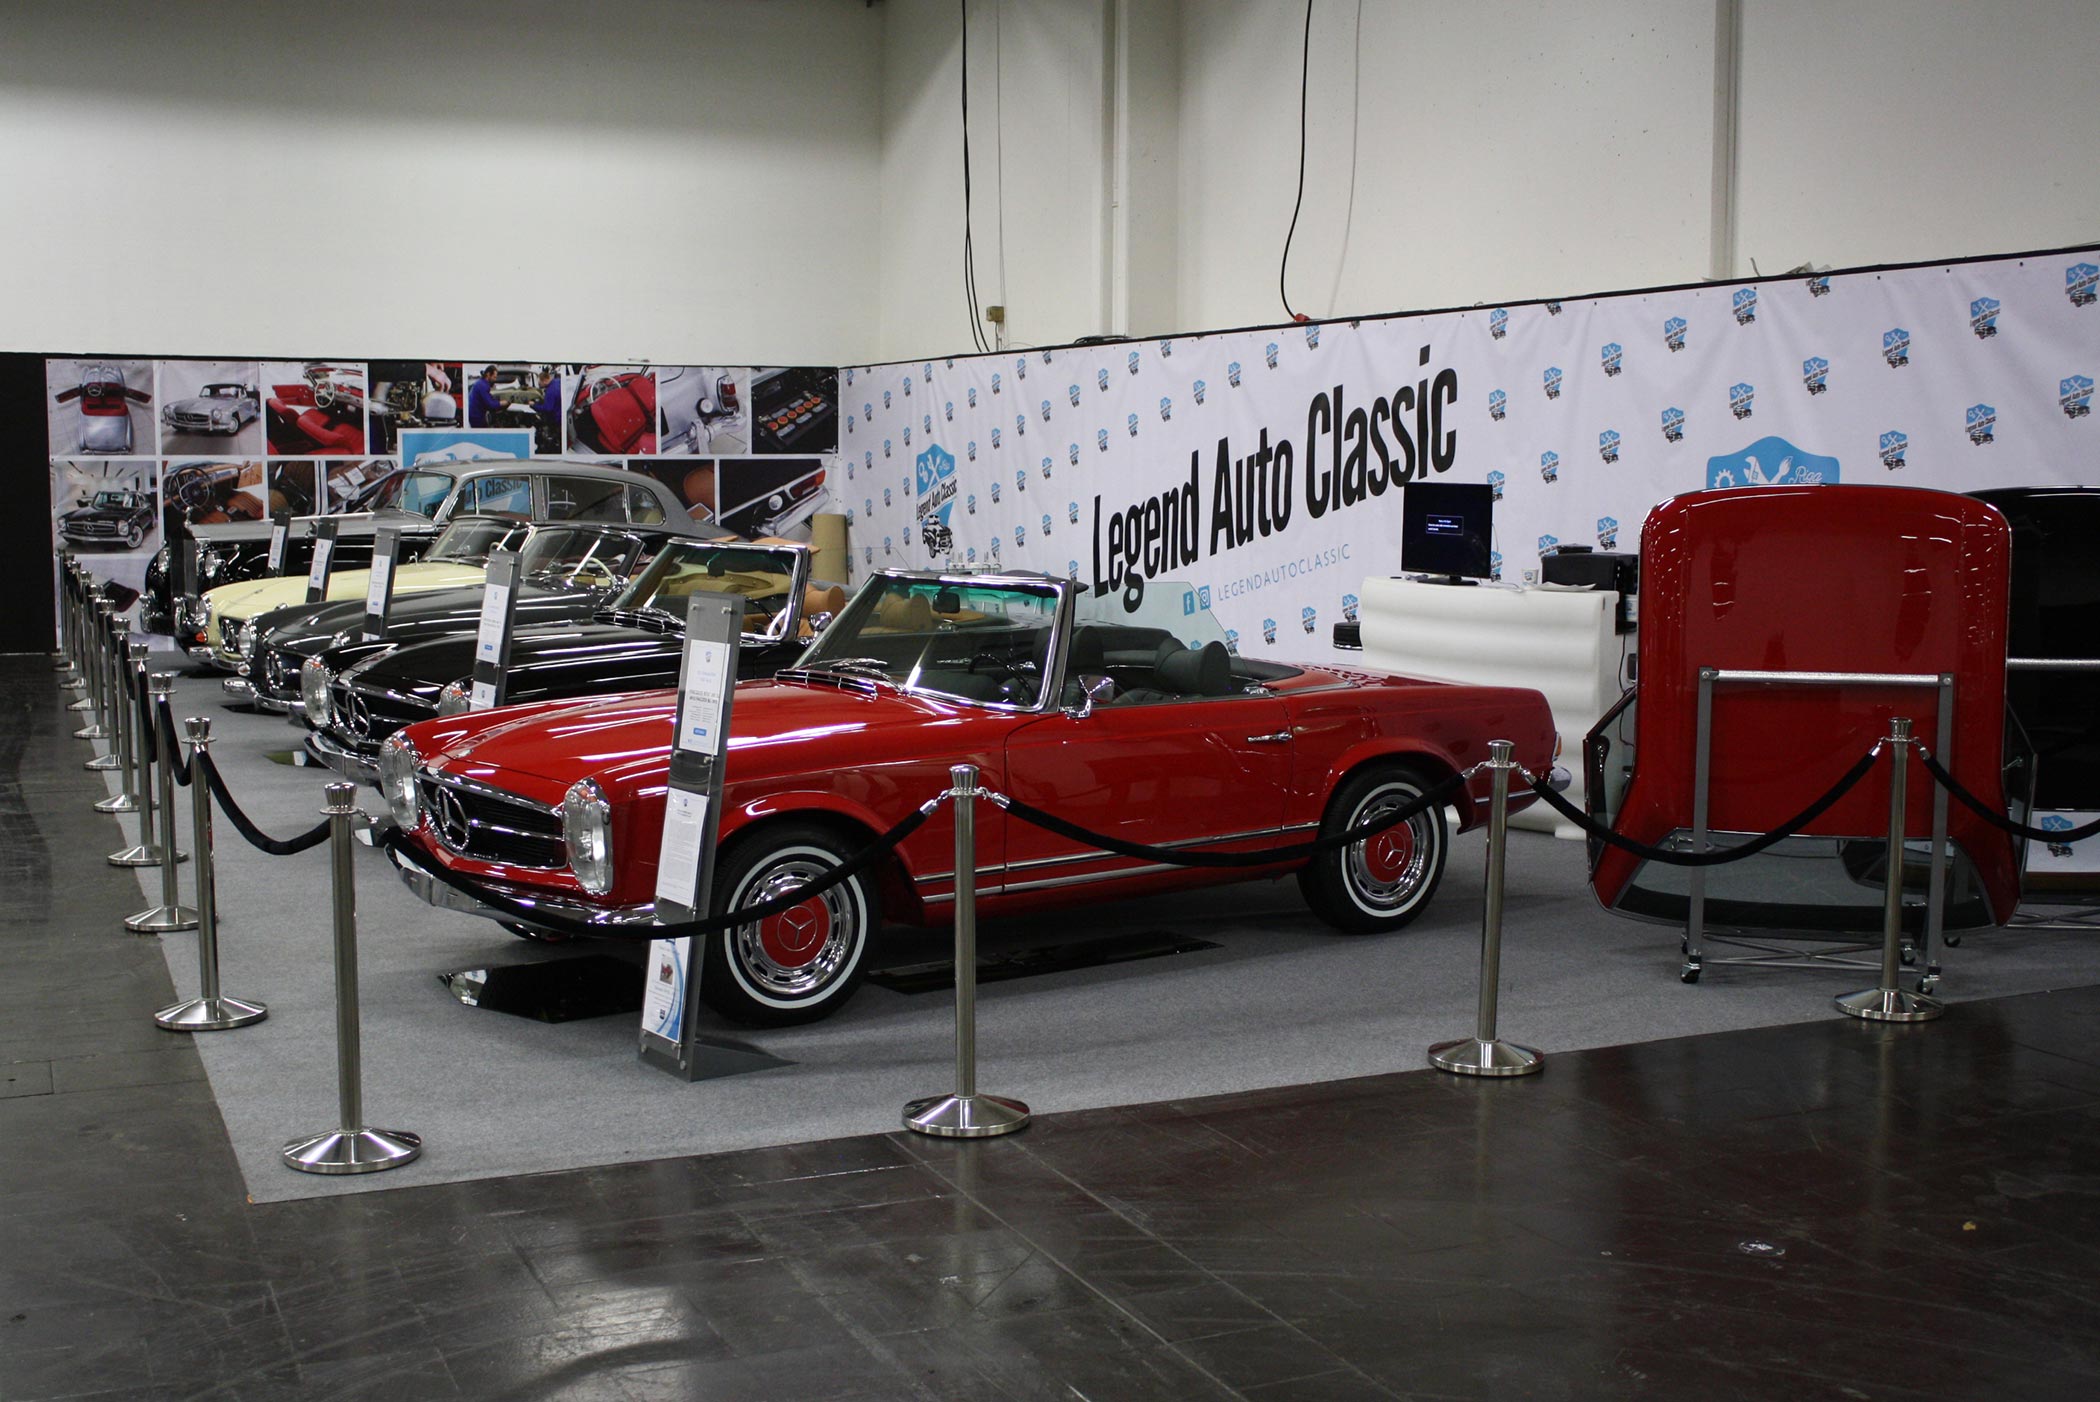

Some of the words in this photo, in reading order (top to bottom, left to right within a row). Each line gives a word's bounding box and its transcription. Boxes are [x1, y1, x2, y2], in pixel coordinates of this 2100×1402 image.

[1093, 449, 1199, 613] Legend
[1209, 427, 1293, 556] Auto
[1305, 344, 1458, 519] Classic
[1217, 544, 1351, 601] LEGENDAUTOCLASSIC
